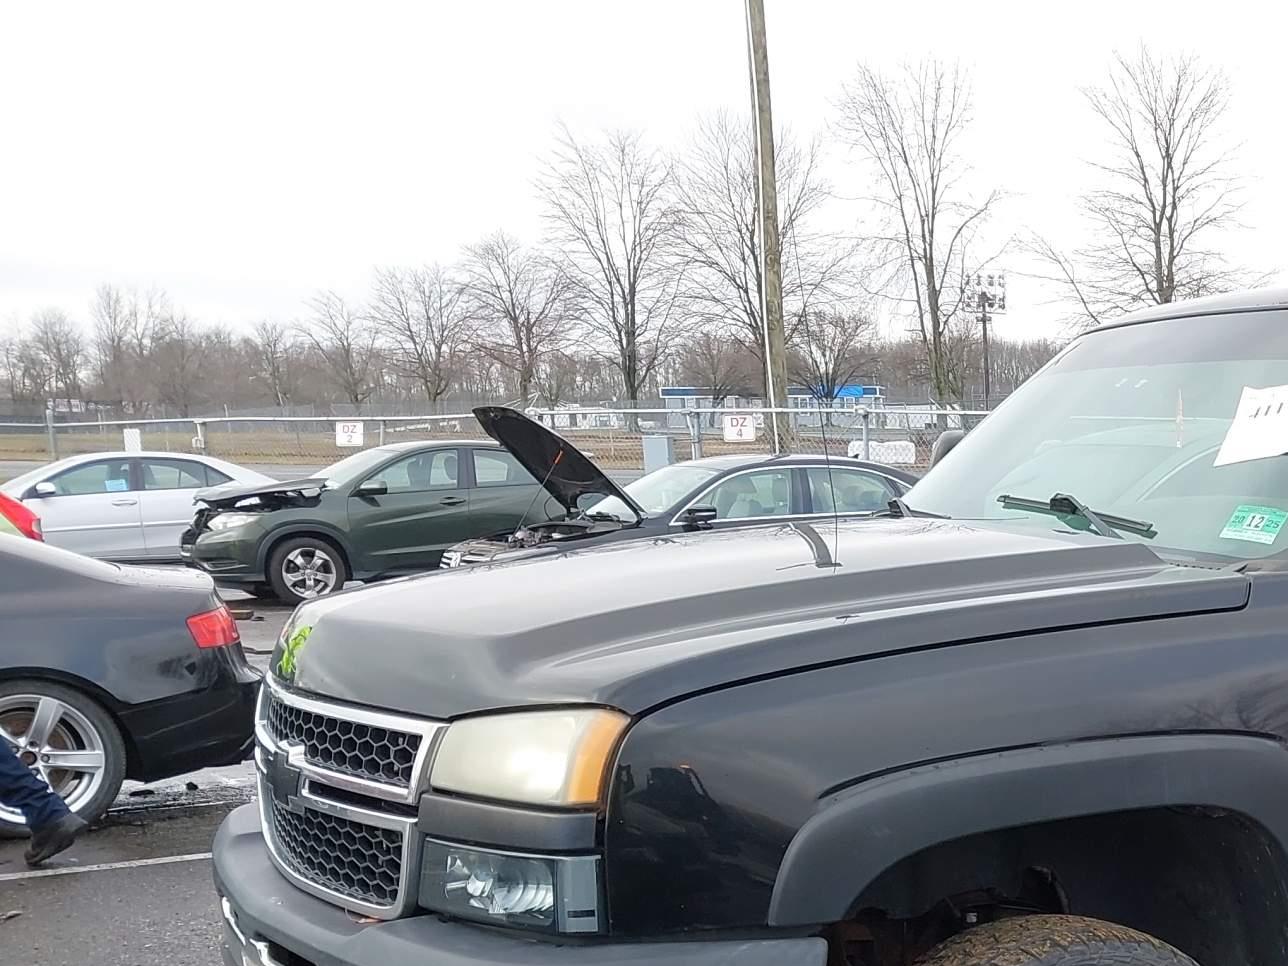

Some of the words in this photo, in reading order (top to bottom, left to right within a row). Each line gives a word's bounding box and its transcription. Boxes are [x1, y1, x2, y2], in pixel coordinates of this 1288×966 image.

[730, 417, 748, 427] DZ
[346, 434, 353, 442] 2
[736, 428, 743, 438] 4
[1246, 514, 1265, 528] 12
[1265, 519, 1280, 528] 25
